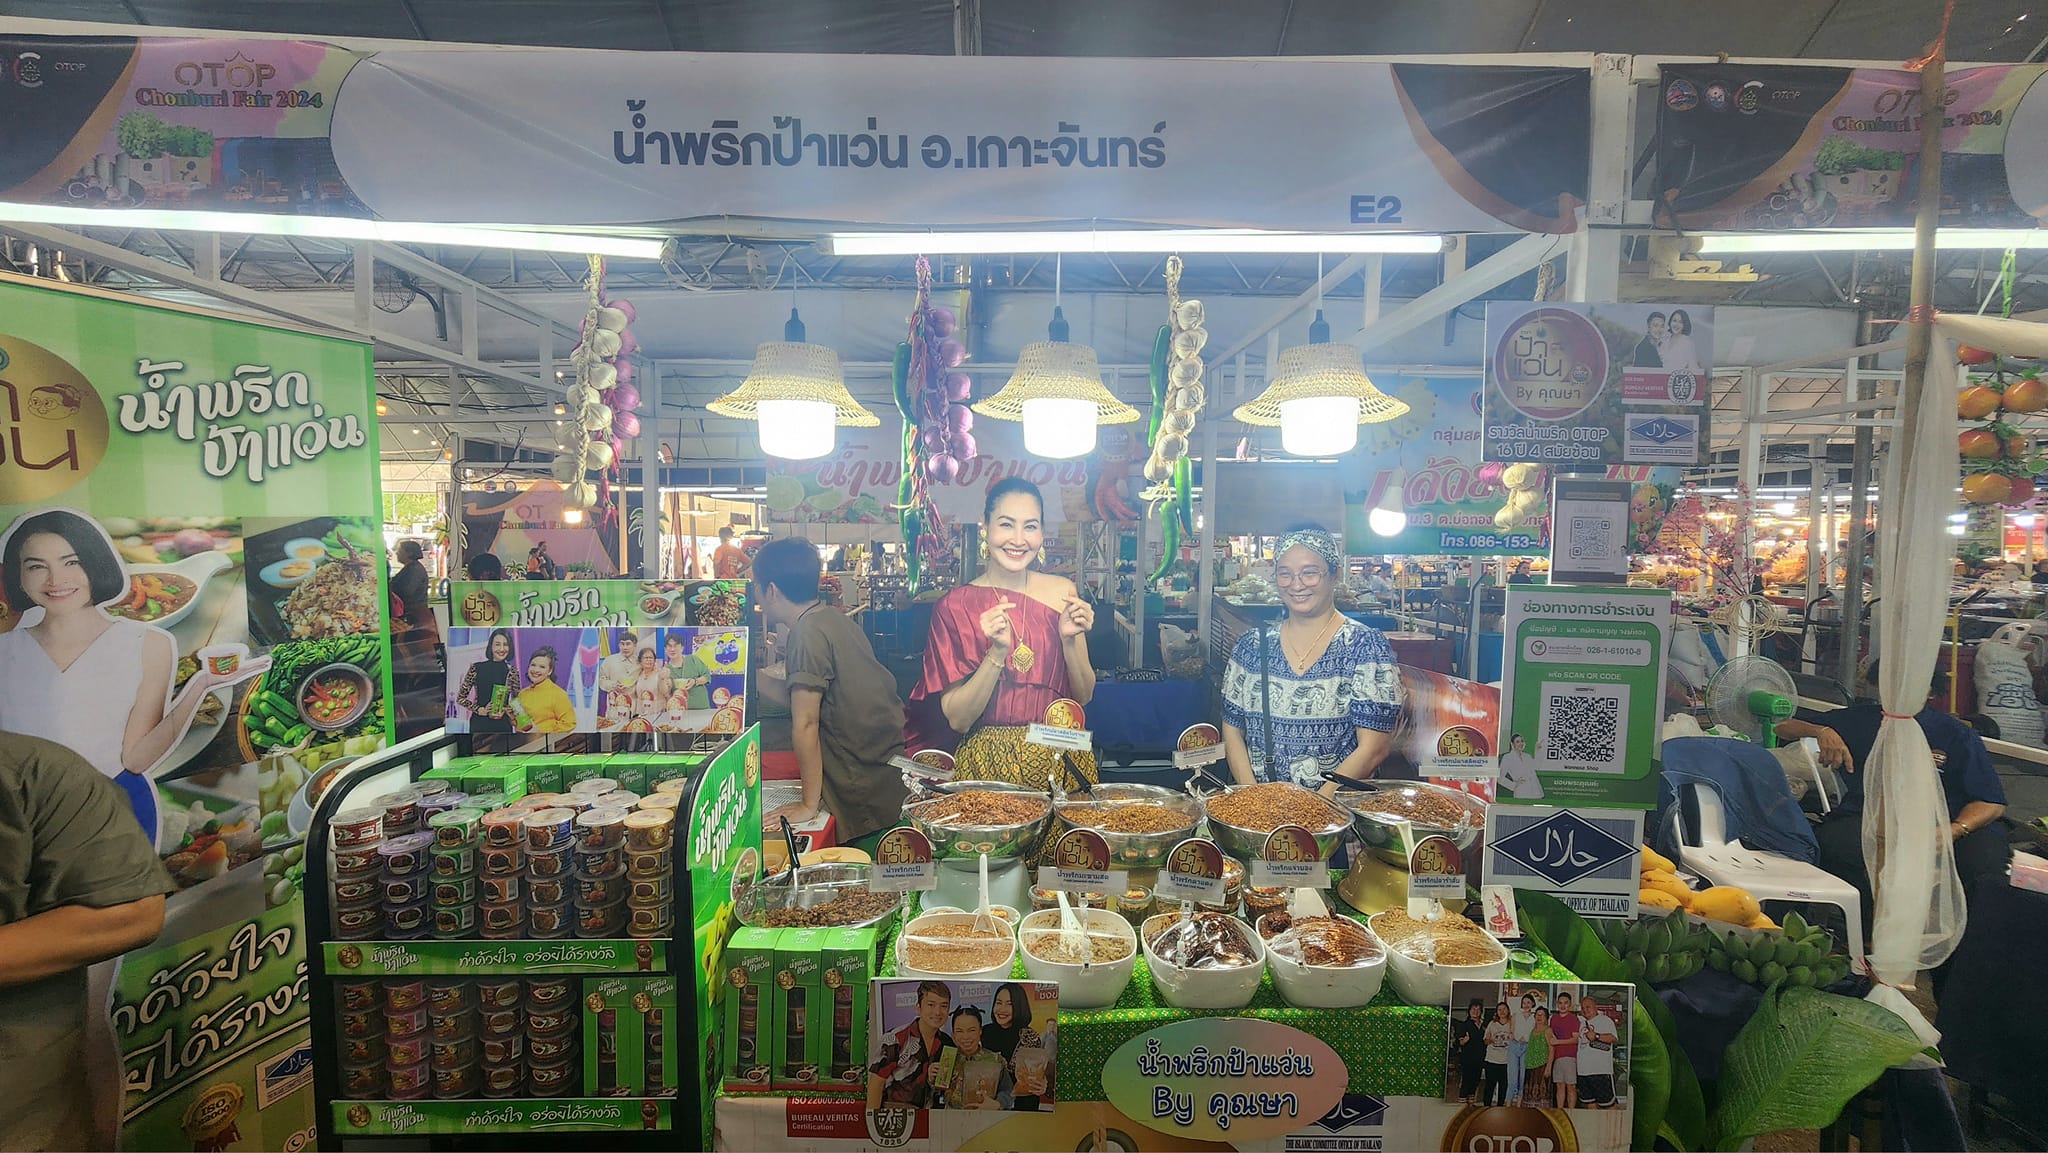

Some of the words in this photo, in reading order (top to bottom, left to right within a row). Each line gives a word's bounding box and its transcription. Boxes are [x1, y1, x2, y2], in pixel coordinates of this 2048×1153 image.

[174, 59, 276, 88] OTOP
[136, 88, 229, 107] Chonburi
[233, 89, 272, 107] Fair
[277, 90, 324, 108] 2024
[613, 99, 909, 168] น้ำพริกป้าแว่น
[921, 120, 1166, 168] อ.เกาะจันทร์
[1350, 195, 1402, 223] E2
[118, 359, 310, 440] น้ำพริก
[1516, 386, 1533, 401] By
[1572, 427, 1609, 441] OTOP
[1646, 423, 1678, 438] حلال
[1497, 444, 1512, 457] 16
[1514, 444, 1526, 457] ปี
[1528, 446, 1540, 457] 4
[1522, 600, 1655, 617] ช่องทางการชำระเงิน
[1529, 827, 1599, 867] حلال
[1588, 899, 1598, 911] OF
[1599, 898, 1630, 912] THAILAND
[1138, 1039, 1313, 1076] น้ำพริกป้าแว่น
[1153, 1085, 1194, 1124] By
[1208, 1091, 1297, 1130] คุณษา
[792, 1123, 834, 1131] Certification
